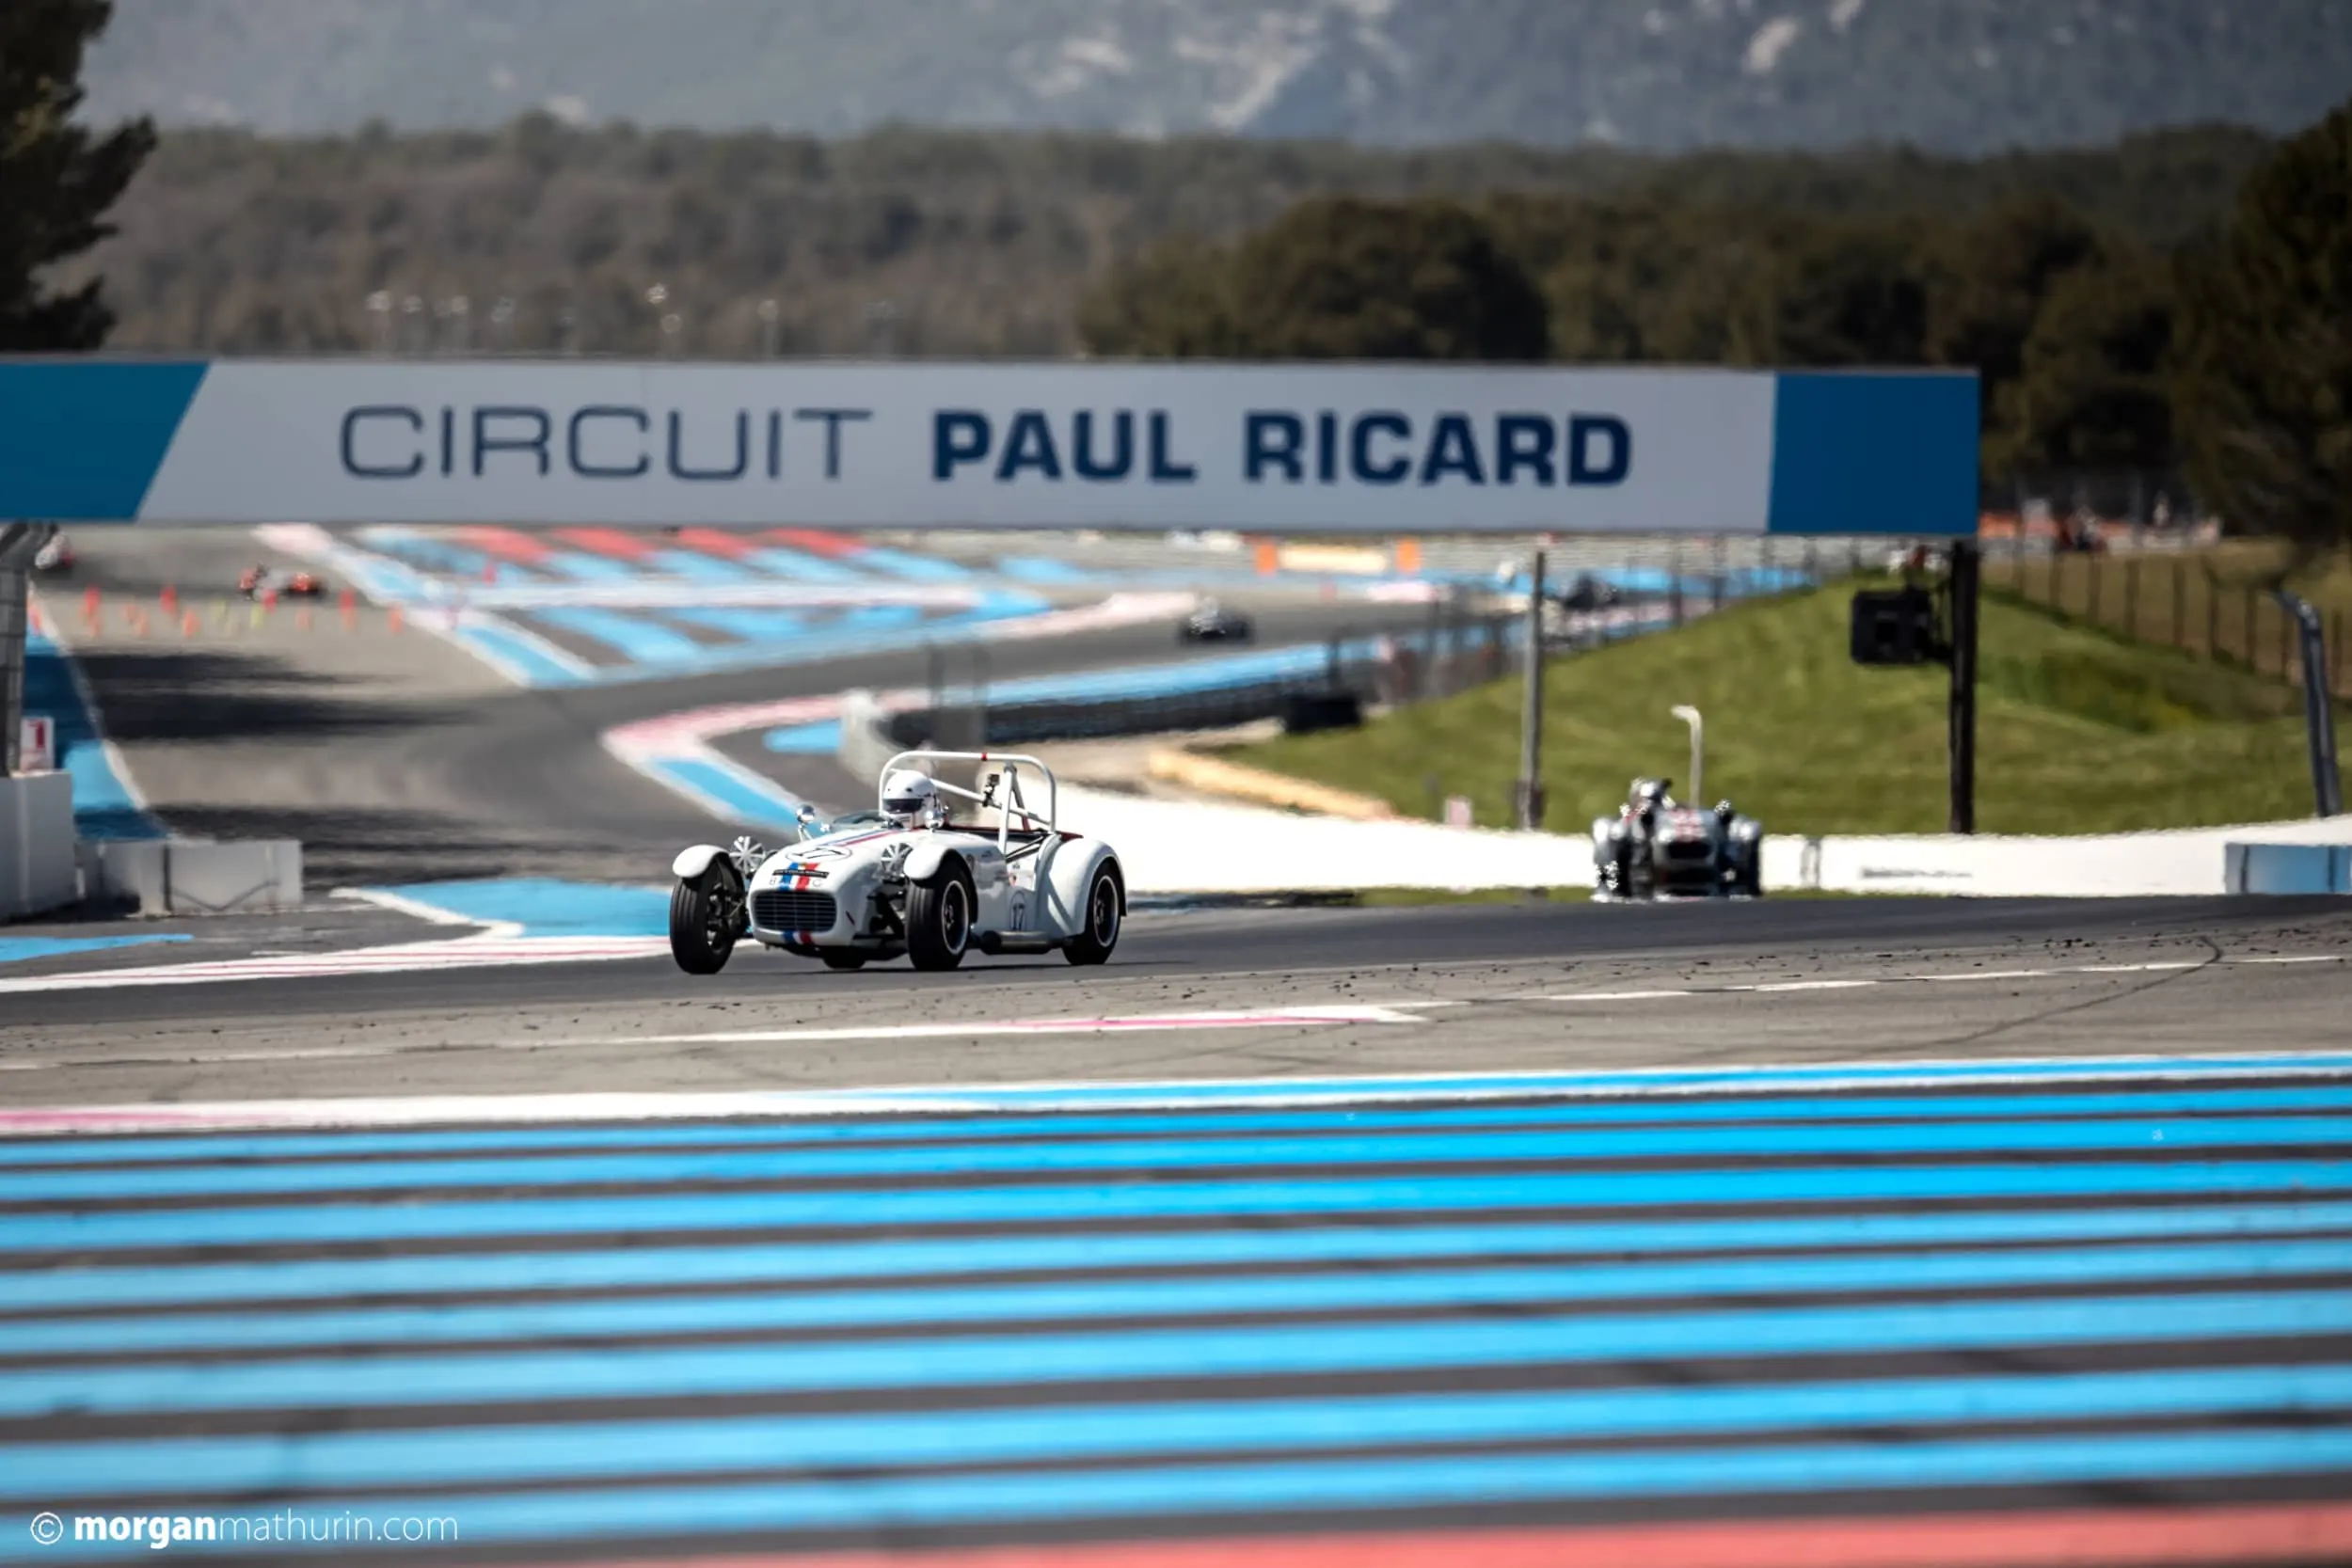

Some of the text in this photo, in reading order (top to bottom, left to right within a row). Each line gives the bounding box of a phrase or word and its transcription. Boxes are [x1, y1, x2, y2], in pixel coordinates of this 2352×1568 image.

[339, 404, 1635, 489] CIRCUIT PAUL RICARD
[1012, 903, 1025, 931] 17
